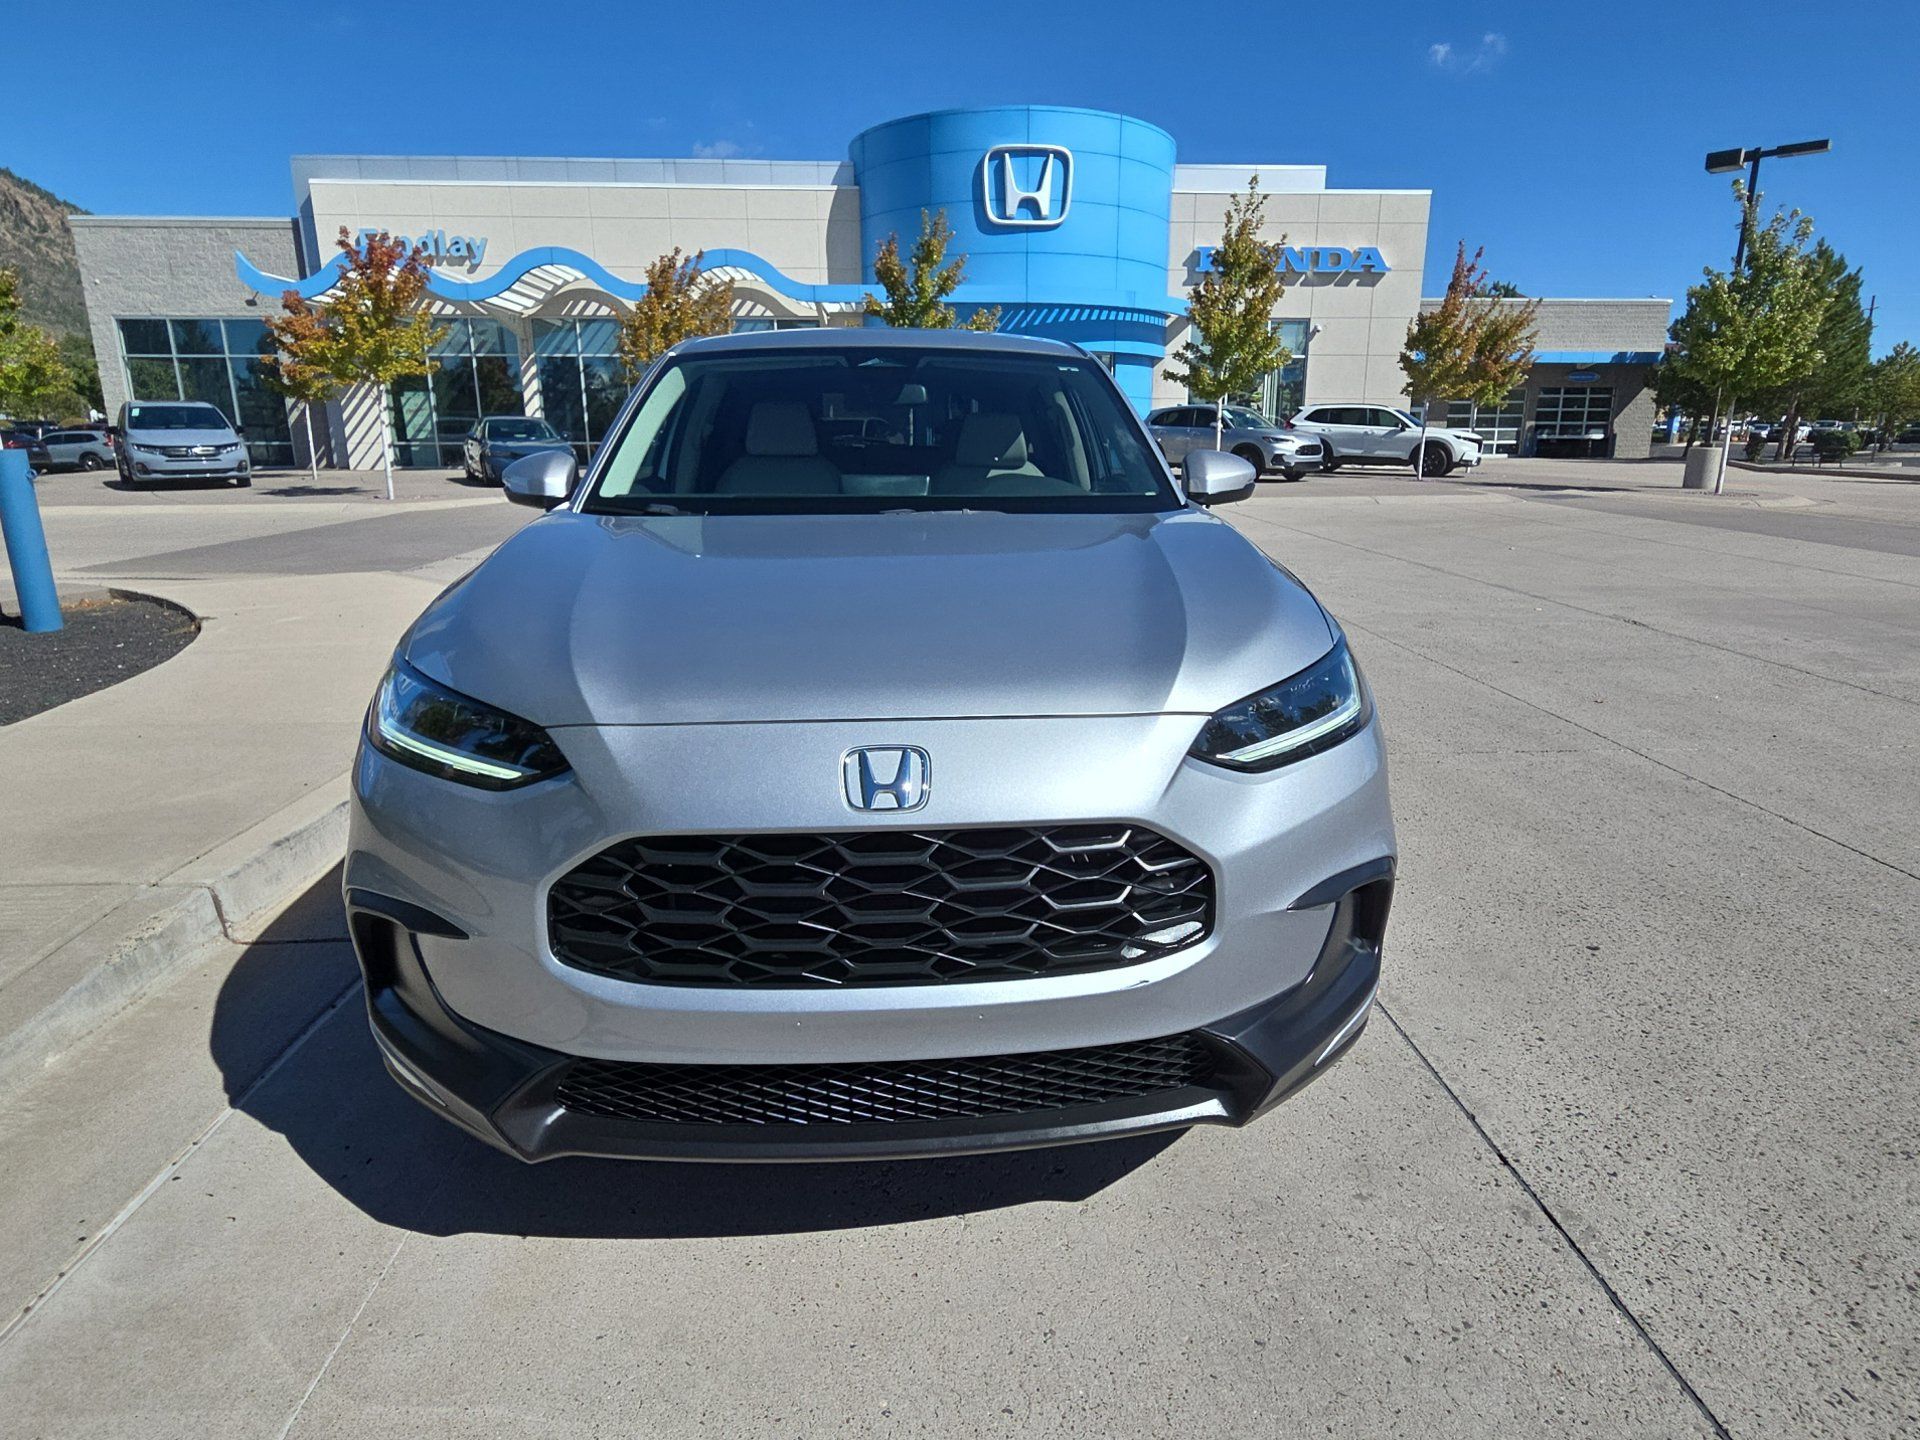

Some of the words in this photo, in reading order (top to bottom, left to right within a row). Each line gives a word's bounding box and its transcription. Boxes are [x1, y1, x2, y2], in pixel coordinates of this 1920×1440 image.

[1004, 152, 1055, 217] H
[1195, 246, 1392, 272] HNDA
[858, 749, 912, 810] H
